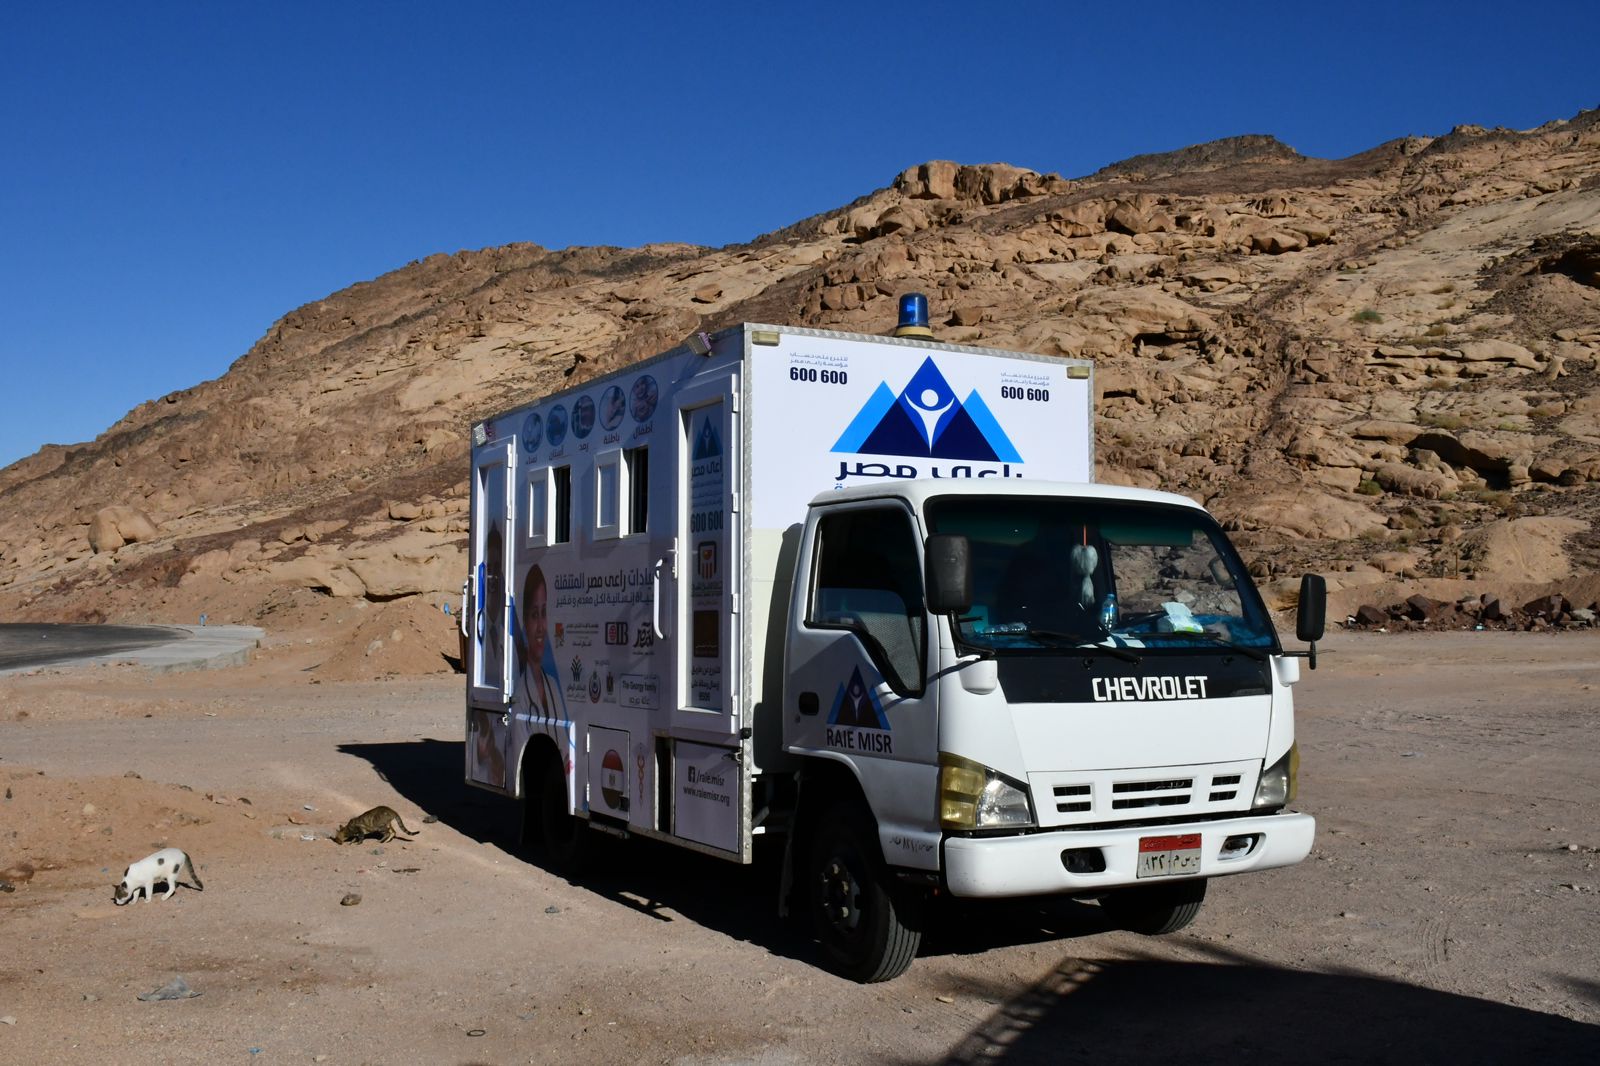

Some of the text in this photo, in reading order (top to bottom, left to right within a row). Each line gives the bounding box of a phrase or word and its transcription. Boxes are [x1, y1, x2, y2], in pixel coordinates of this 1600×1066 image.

[790, 366, 848, 385] 600 600
[1001, 385, 1050, 402] 600 600
[835, 461, 918, 481] مصر
[586, 575, 603, 594] مصر
[1091, 676, 1208, 701] CHEVROLET
[826, 728, 893, 754] RAIE MISR
